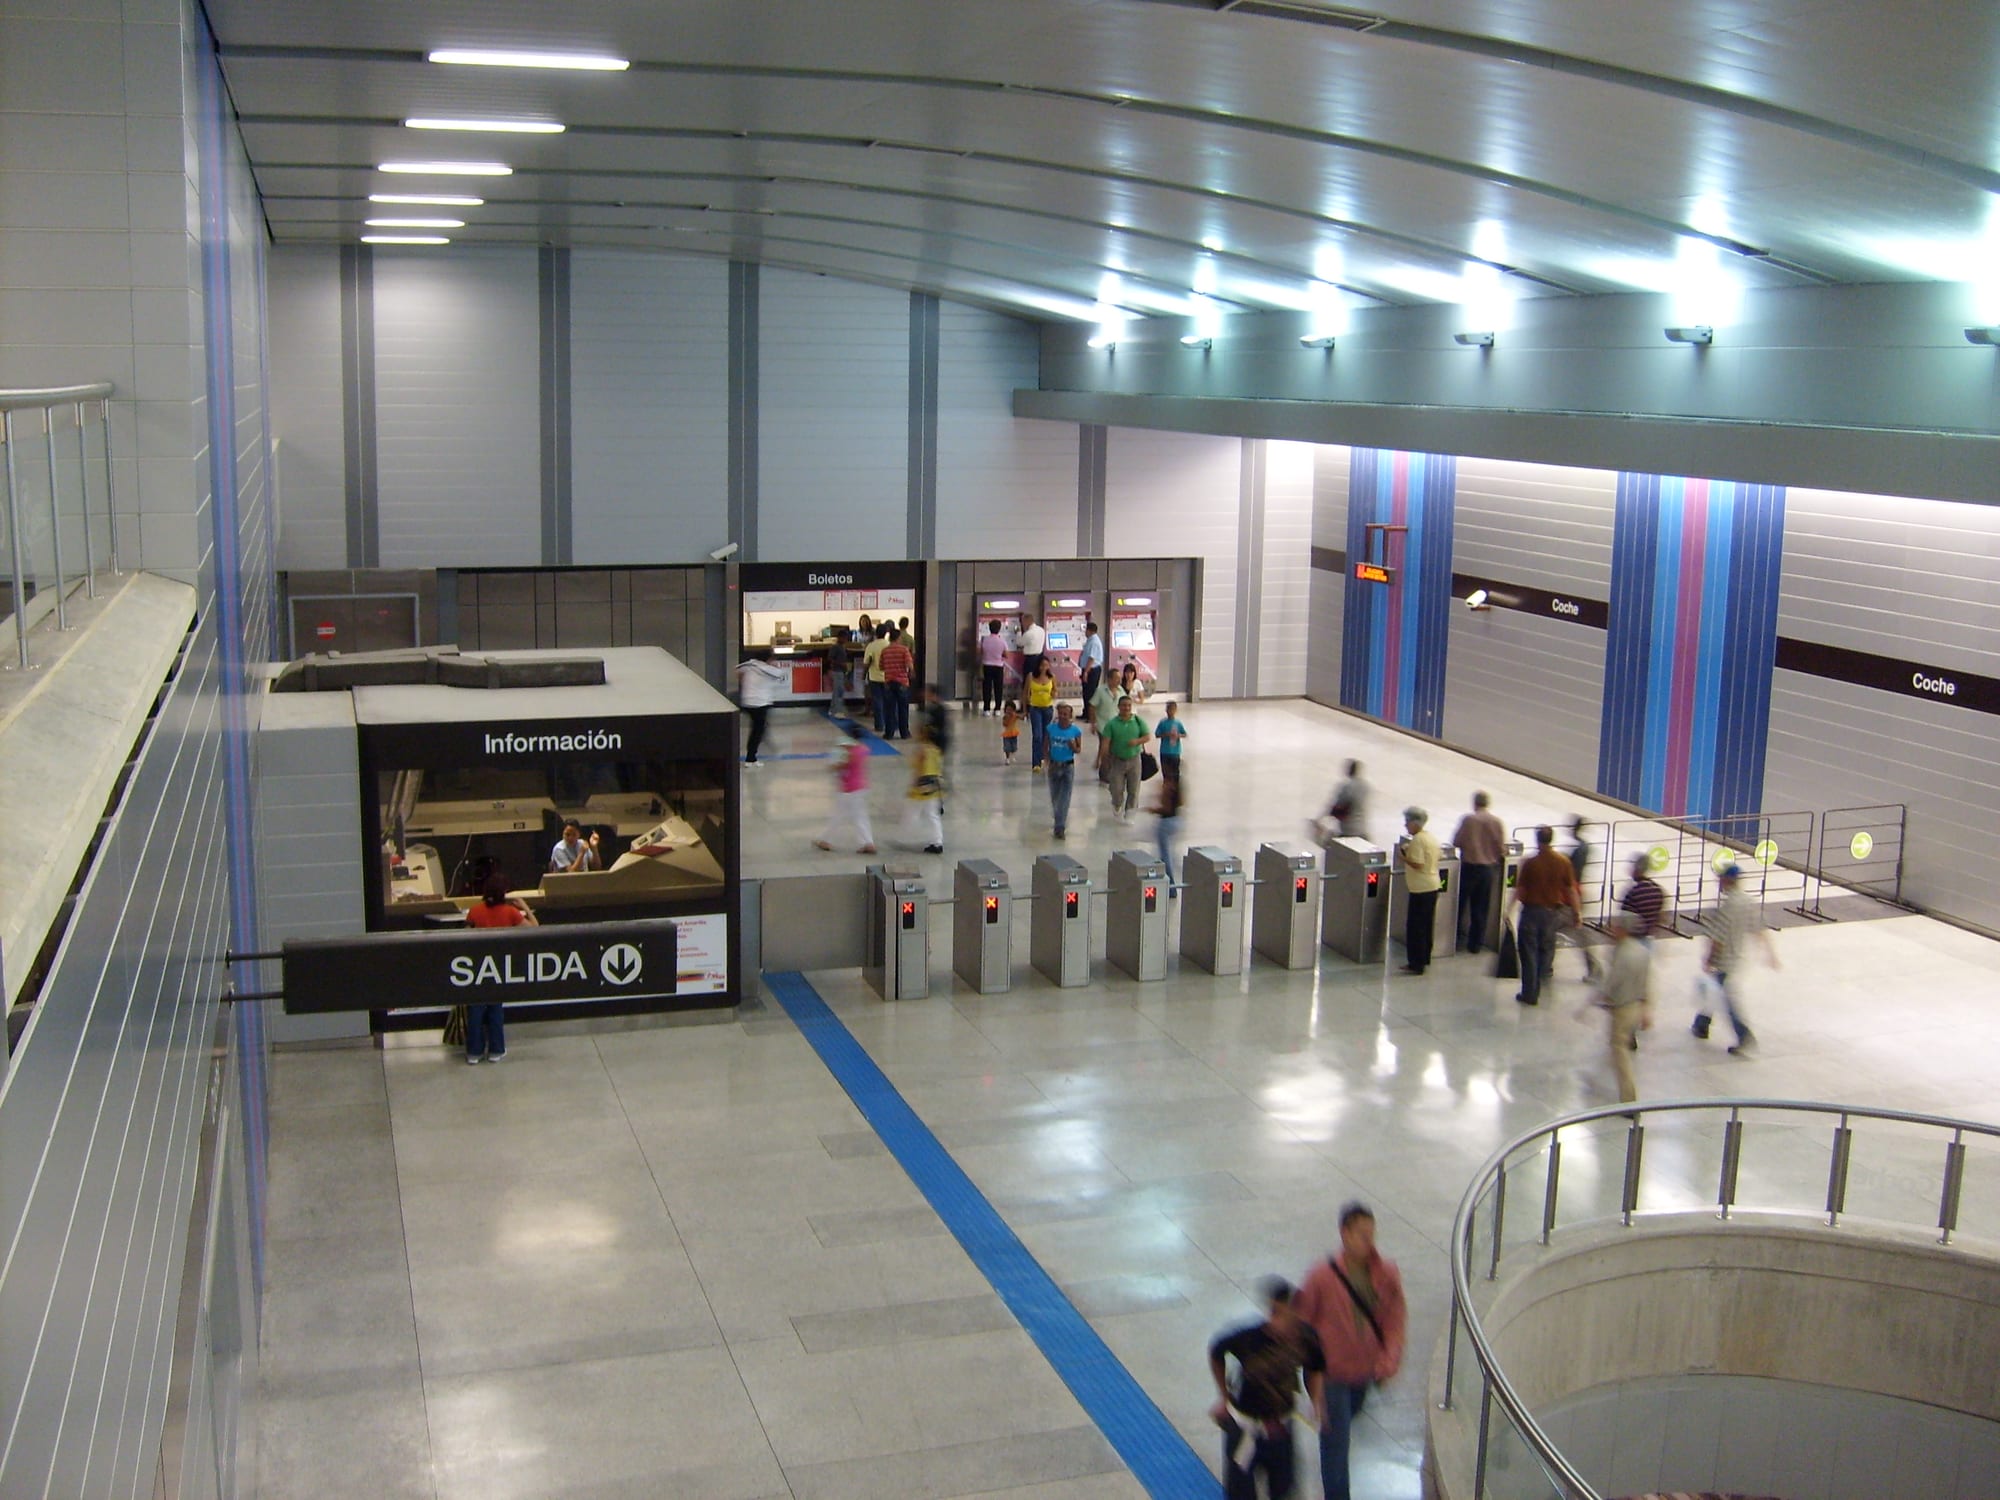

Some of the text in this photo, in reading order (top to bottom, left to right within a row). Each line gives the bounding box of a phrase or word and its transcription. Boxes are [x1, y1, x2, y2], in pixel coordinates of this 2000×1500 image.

[808, 573, 853, 585] Boletos
[1552, 598, 1579, 616] Coche
[1912, 672, 1955, 696] Coche
[484, 729, 622, 754] Información
[450, 951, 588, 987] SALIDA
